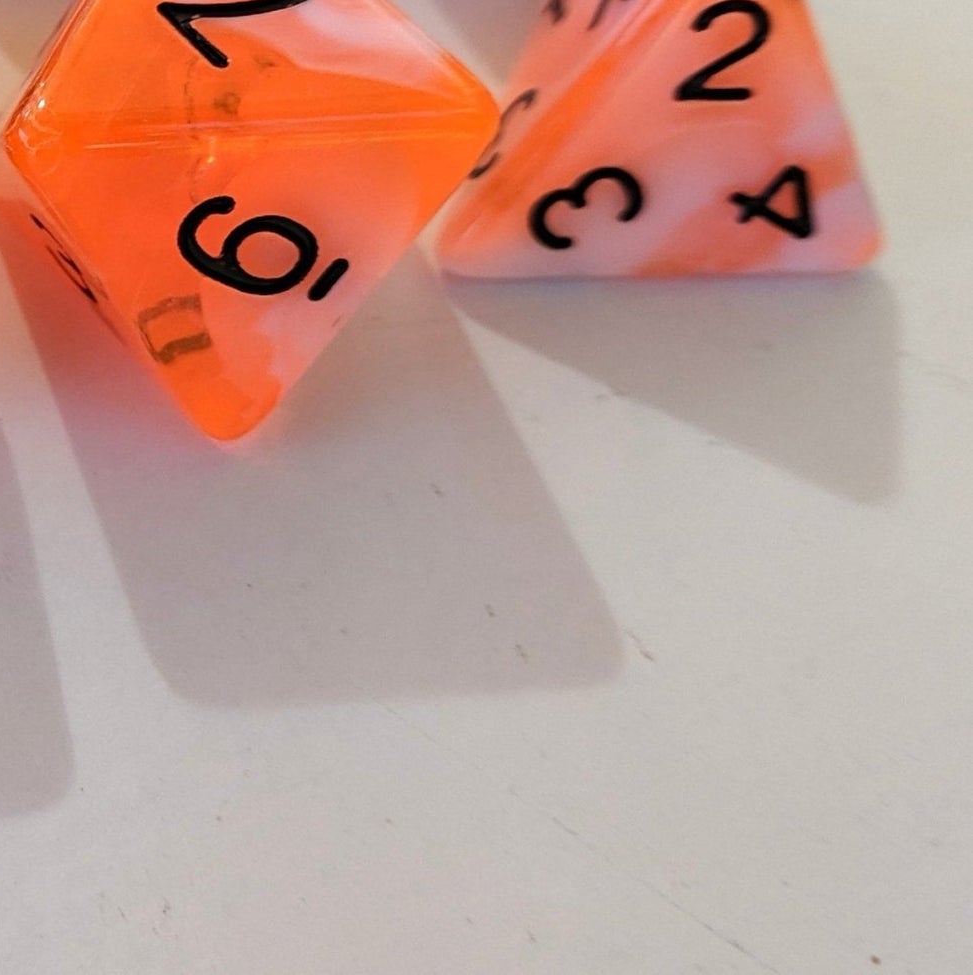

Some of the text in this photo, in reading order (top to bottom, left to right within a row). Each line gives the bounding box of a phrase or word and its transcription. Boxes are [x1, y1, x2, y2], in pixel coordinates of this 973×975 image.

[674, 0, 771, 102] 2
[529, 166, 645, 250] 3
[727, 165, 816, 240] 4
